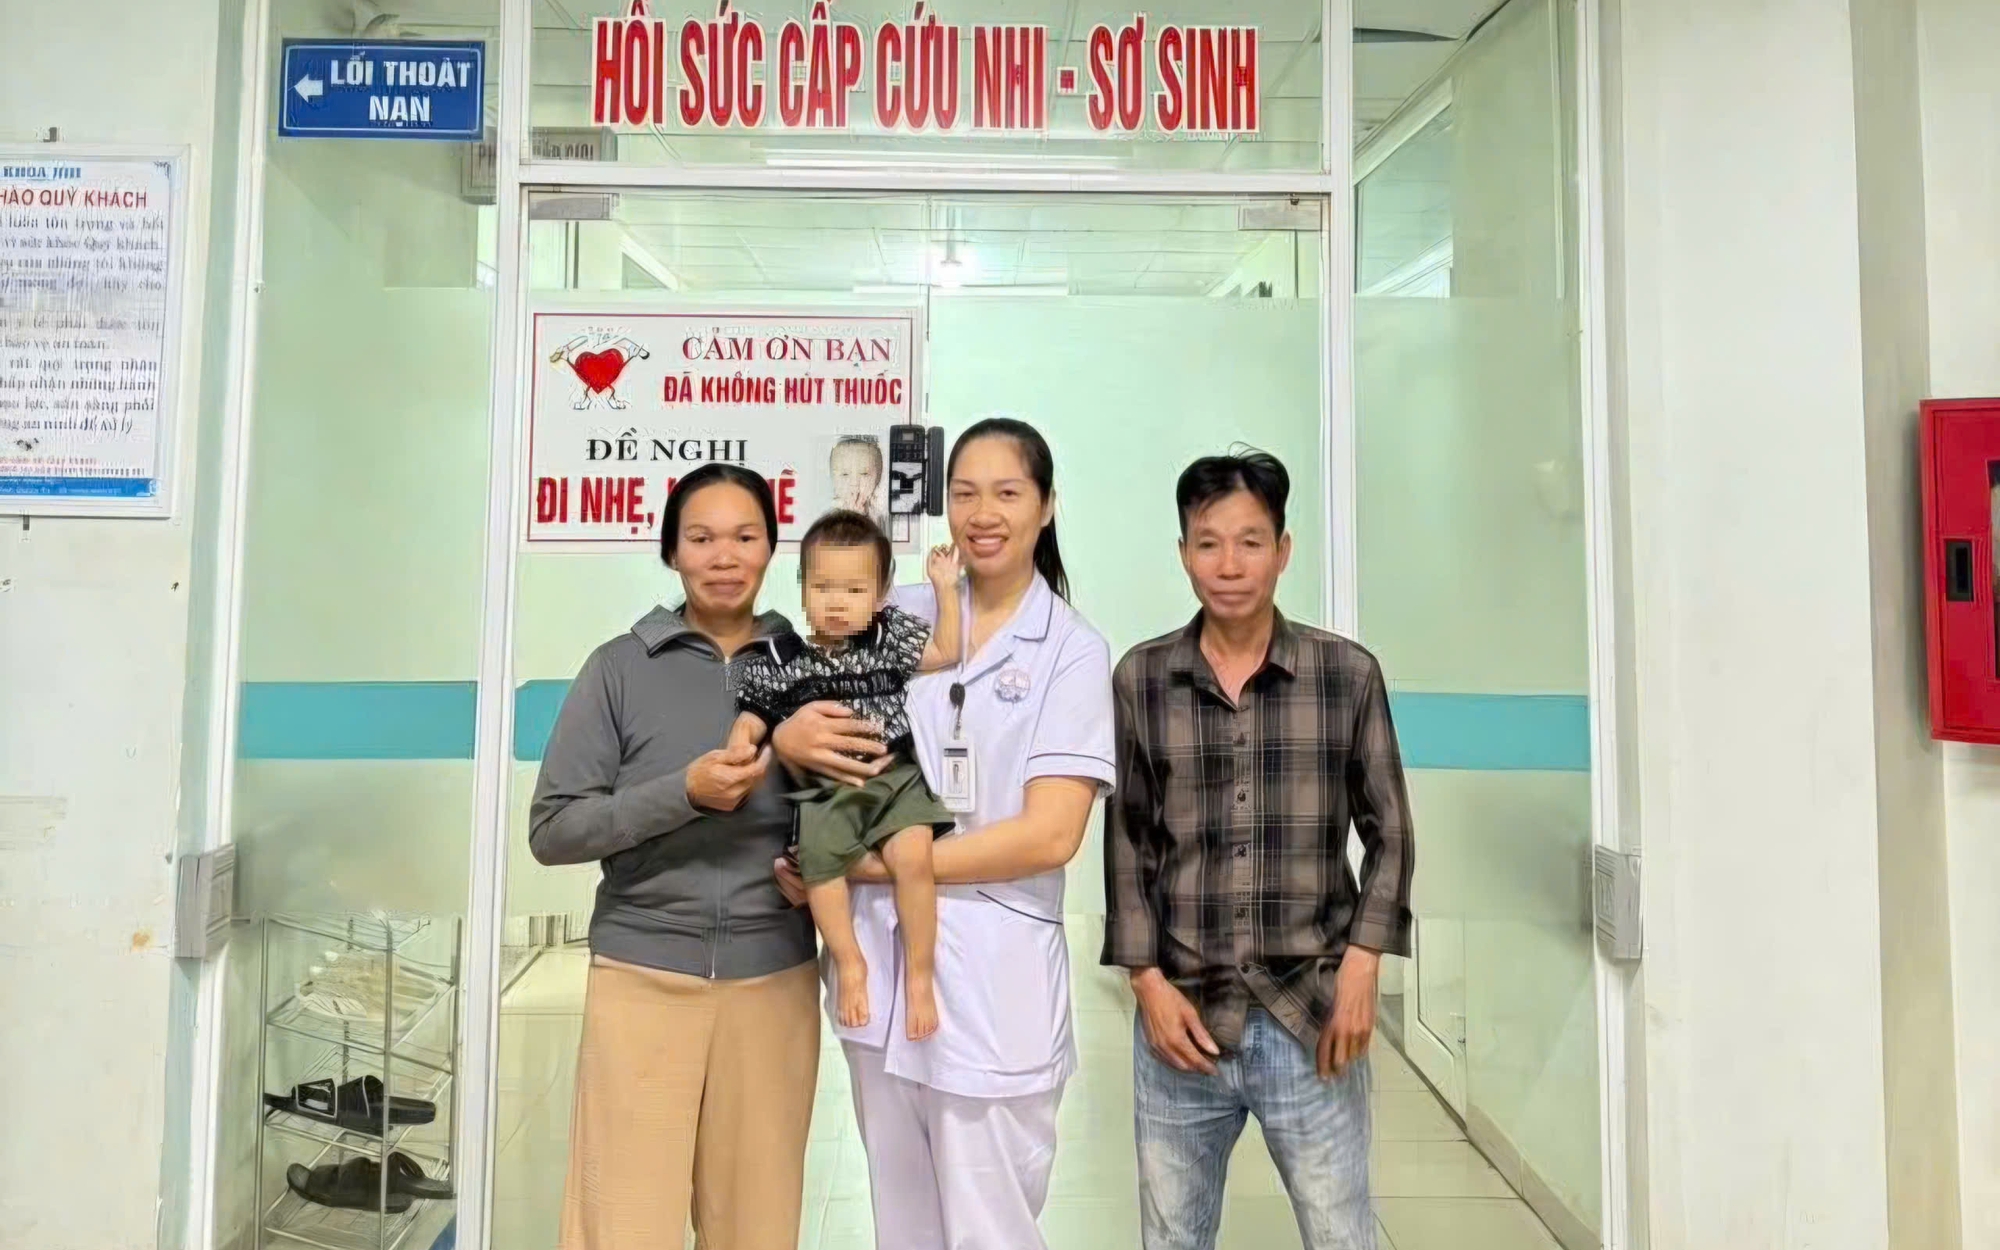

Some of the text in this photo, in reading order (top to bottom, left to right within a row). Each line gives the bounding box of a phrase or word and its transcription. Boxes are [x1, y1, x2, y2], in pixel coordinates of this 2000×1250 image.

[330, 51, 471, 87] LỐI THOÁT
[679, 0, 763, 126] SỨC
[779, 0, 862, 128] CẤP
[876, 1, 960, 129] CỨU
[973, 26, 1045, 129] NHI
[1088, 16, 1146, 130] SƠ
[1157, 26, 1256, 130] SINH
[369, 95, 431, 127] NẠN
[682, 327, 892, 367] CẢM ƠN BẠN
[664, 370, 903, 405] ĐÃ KHÔNG HÚT THUỐC
[586, 427, 748, 466] ĐỀ NGHỊ
[536, 476, 568, 524] ĐI
[580, 476, 655, 534] NHẸ,
